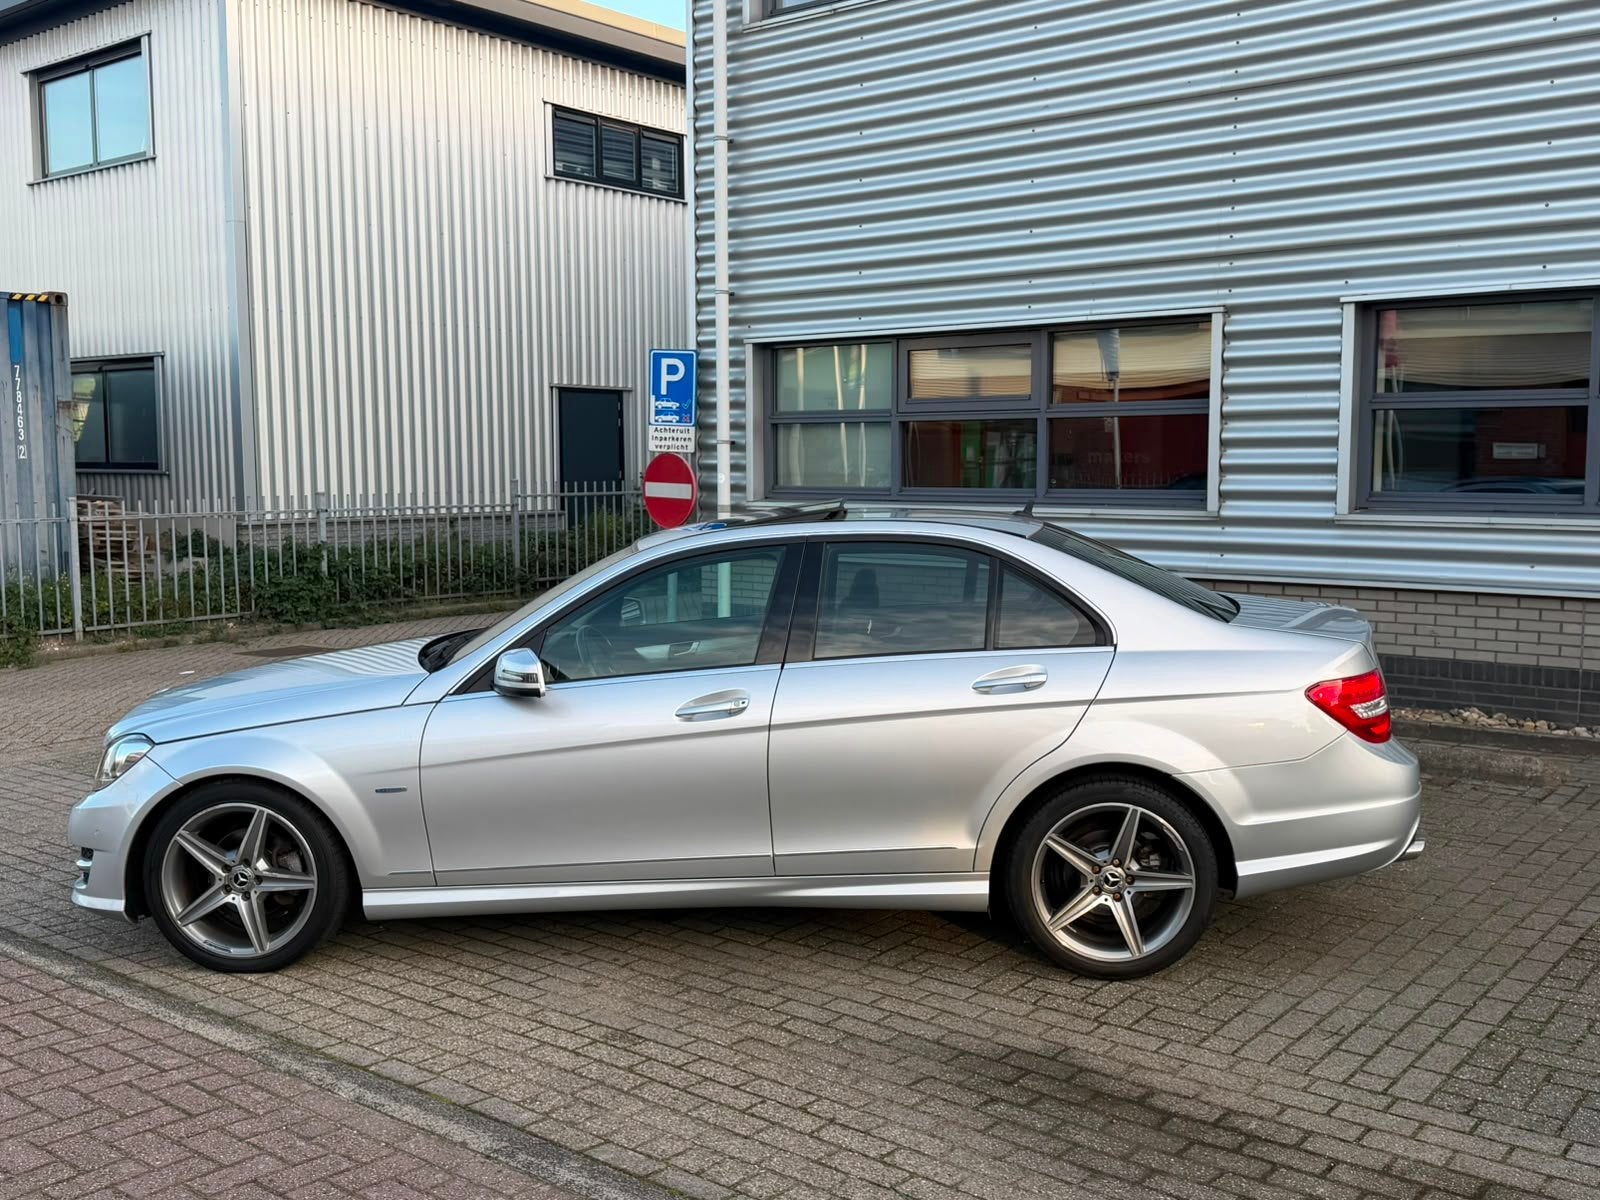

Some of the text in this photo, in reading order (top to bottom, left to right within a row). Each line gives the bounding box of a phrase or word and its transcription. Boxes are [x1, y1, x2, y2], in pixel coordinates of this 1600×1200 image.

[660, 358, 686, 395] P
[14, 365, 27, 459] 778463 2
